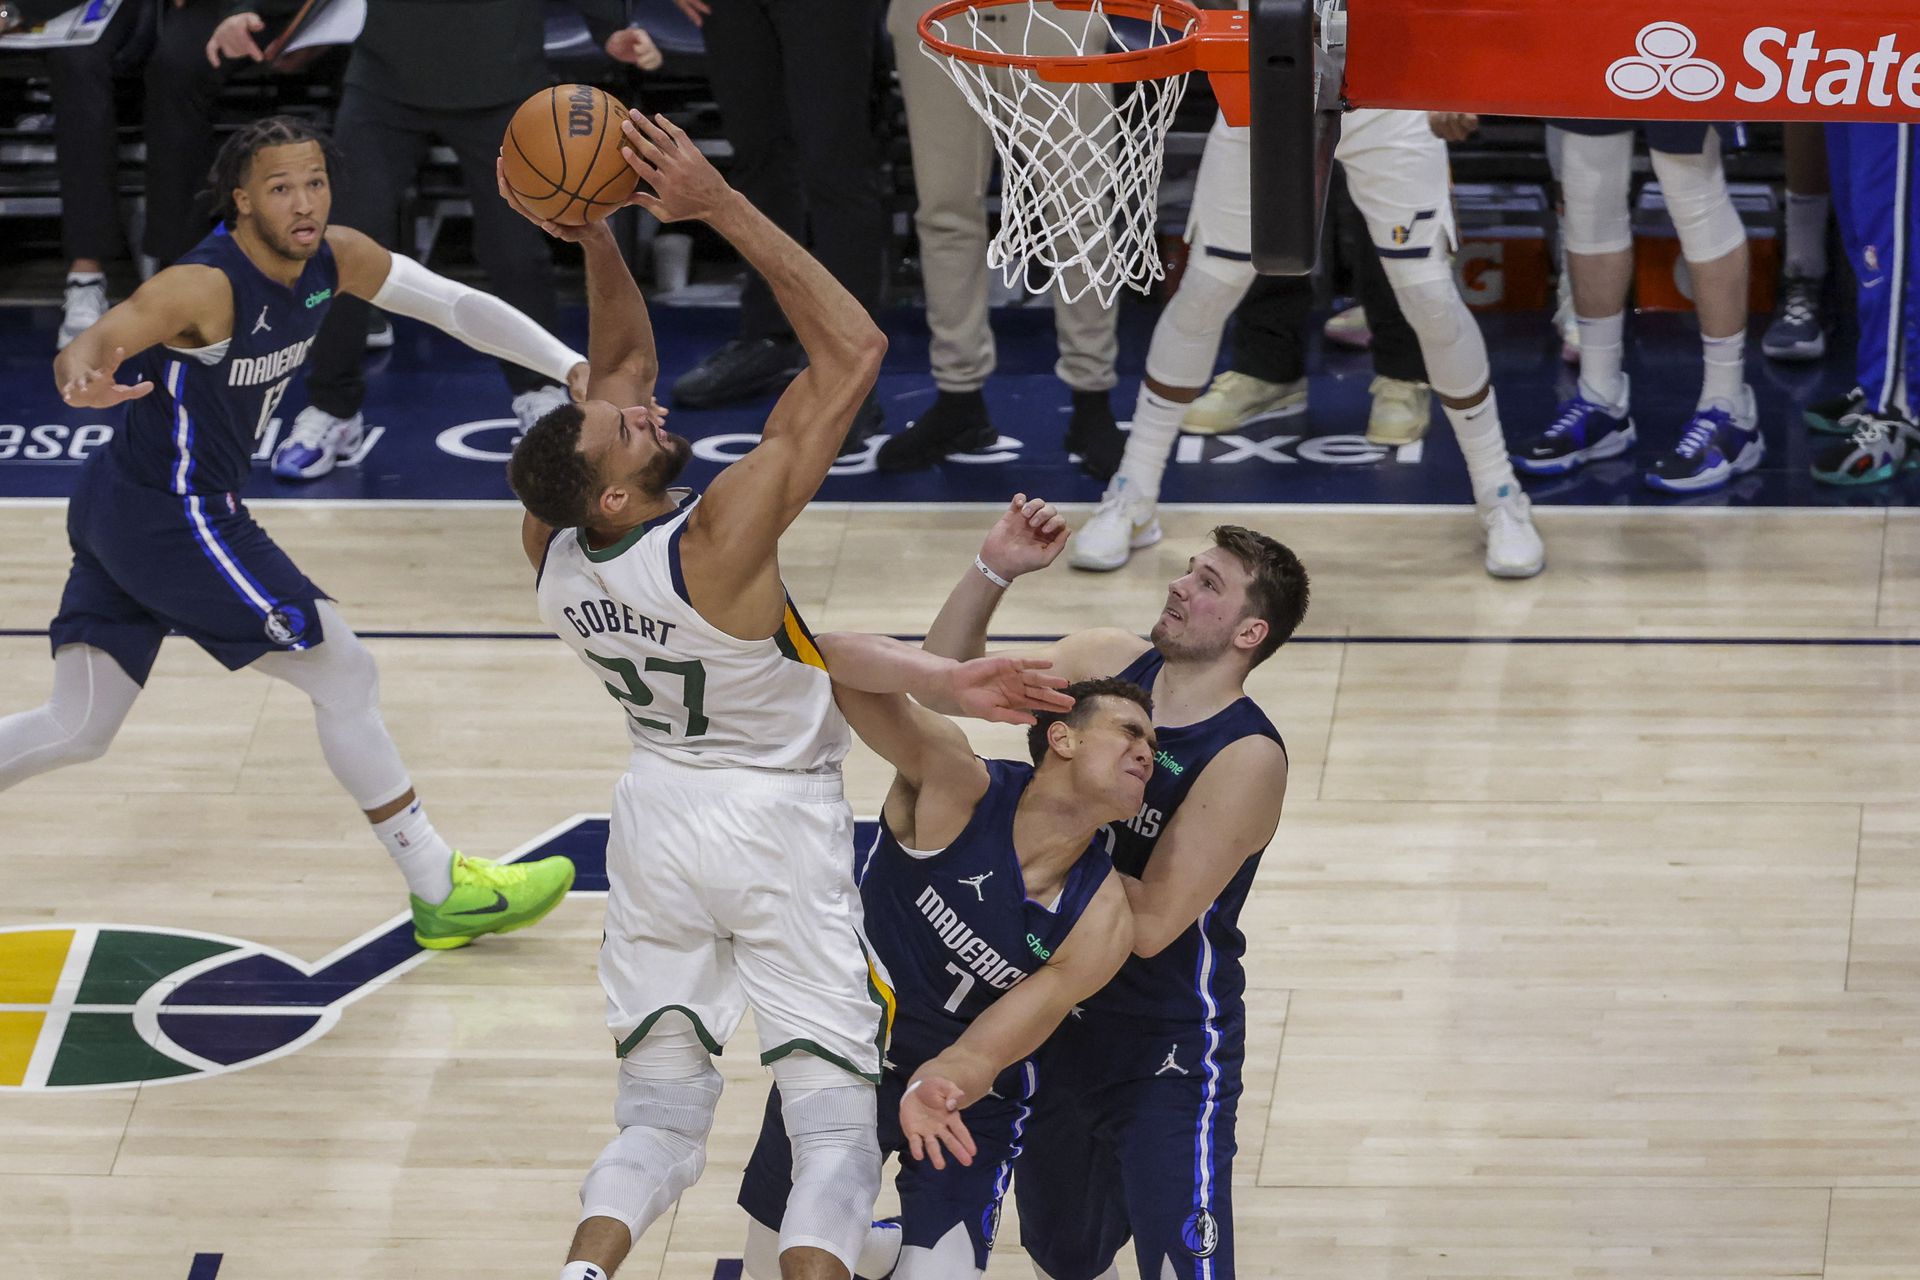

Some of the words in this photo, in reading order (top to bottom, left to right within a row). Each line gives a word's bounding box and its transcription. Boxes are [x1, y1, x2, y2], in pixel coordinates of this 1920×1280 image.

[1735, 26, 1920, 109] State
[563, 599, 676, 647] GOBERT
[584, 648, 710, 738] 27
[944, 961, 976, 1013] 7
